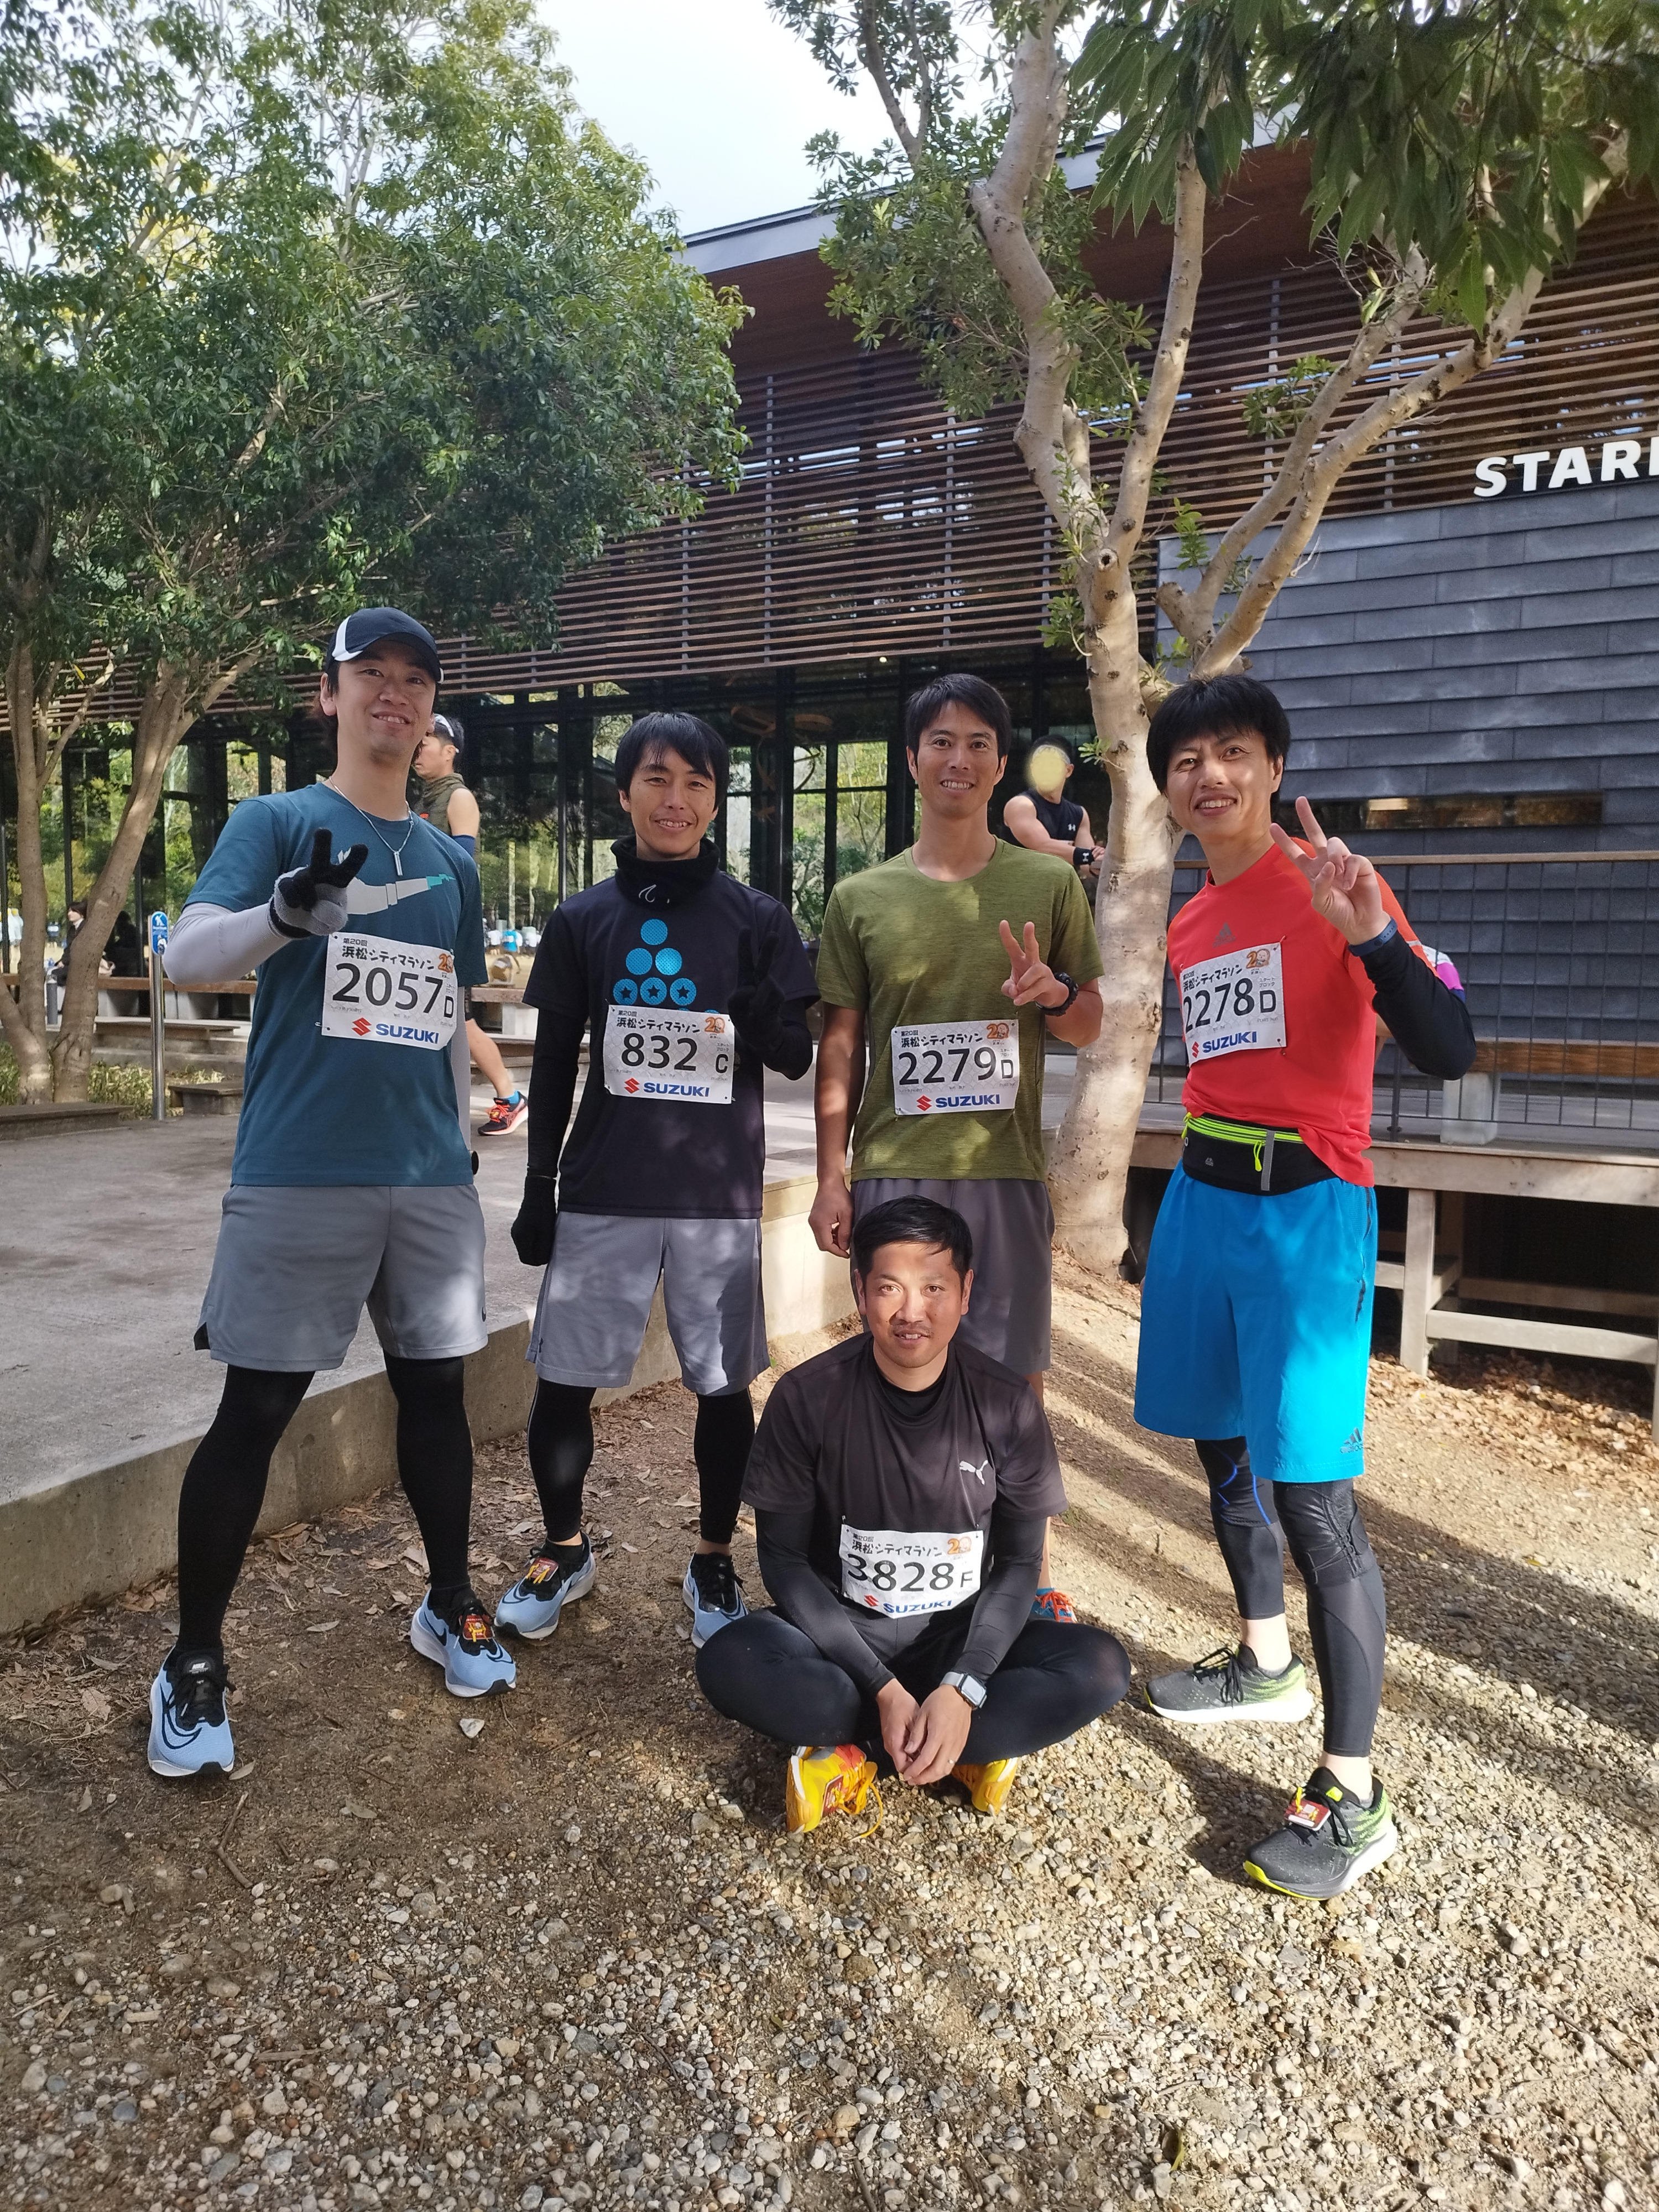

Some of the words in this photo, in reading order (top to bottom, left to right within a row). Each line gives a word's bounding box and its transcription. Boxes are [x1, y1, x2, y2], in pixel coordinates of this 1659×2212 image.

[1473, 436, 1659, 497] STAR
[343, 937, 368, 947] 第20回
[341, 945, 435, 970] 浜松シティマラソン
[332, 962, 444, 1014] 2057
[444, 995, 455, 1018] D
[1183, 978, 1255, 1034] 2278
[1259, 990, 1276, 1013] D
[375, 1023, 439, 1044] SUZUKI
[616, 1017, 700, 1033] 浜松シティマラソン
[901, 1033, 984, 1048] 浜松シティマラソン
[1202, 1031, 1257, 1053] SUZUKI
[621, 1032, 697, 1071] 832
[715, 1054, 729, 1073] C
[898, 1047, 997, 1086] 2279
[1001, 1059, 1014, 1079] D
[643, 1082, 710, 1097] SUZUKI
[935, 1094, 1000, 1108] SUZUKI
[852, 1540, 942, 1557] 浜松シティマラソン
[847, 1553, 954, 1592] 3828
[960, 1570, 973, 1588] F
[883, 1600, 952, 1614] SUZUKI
